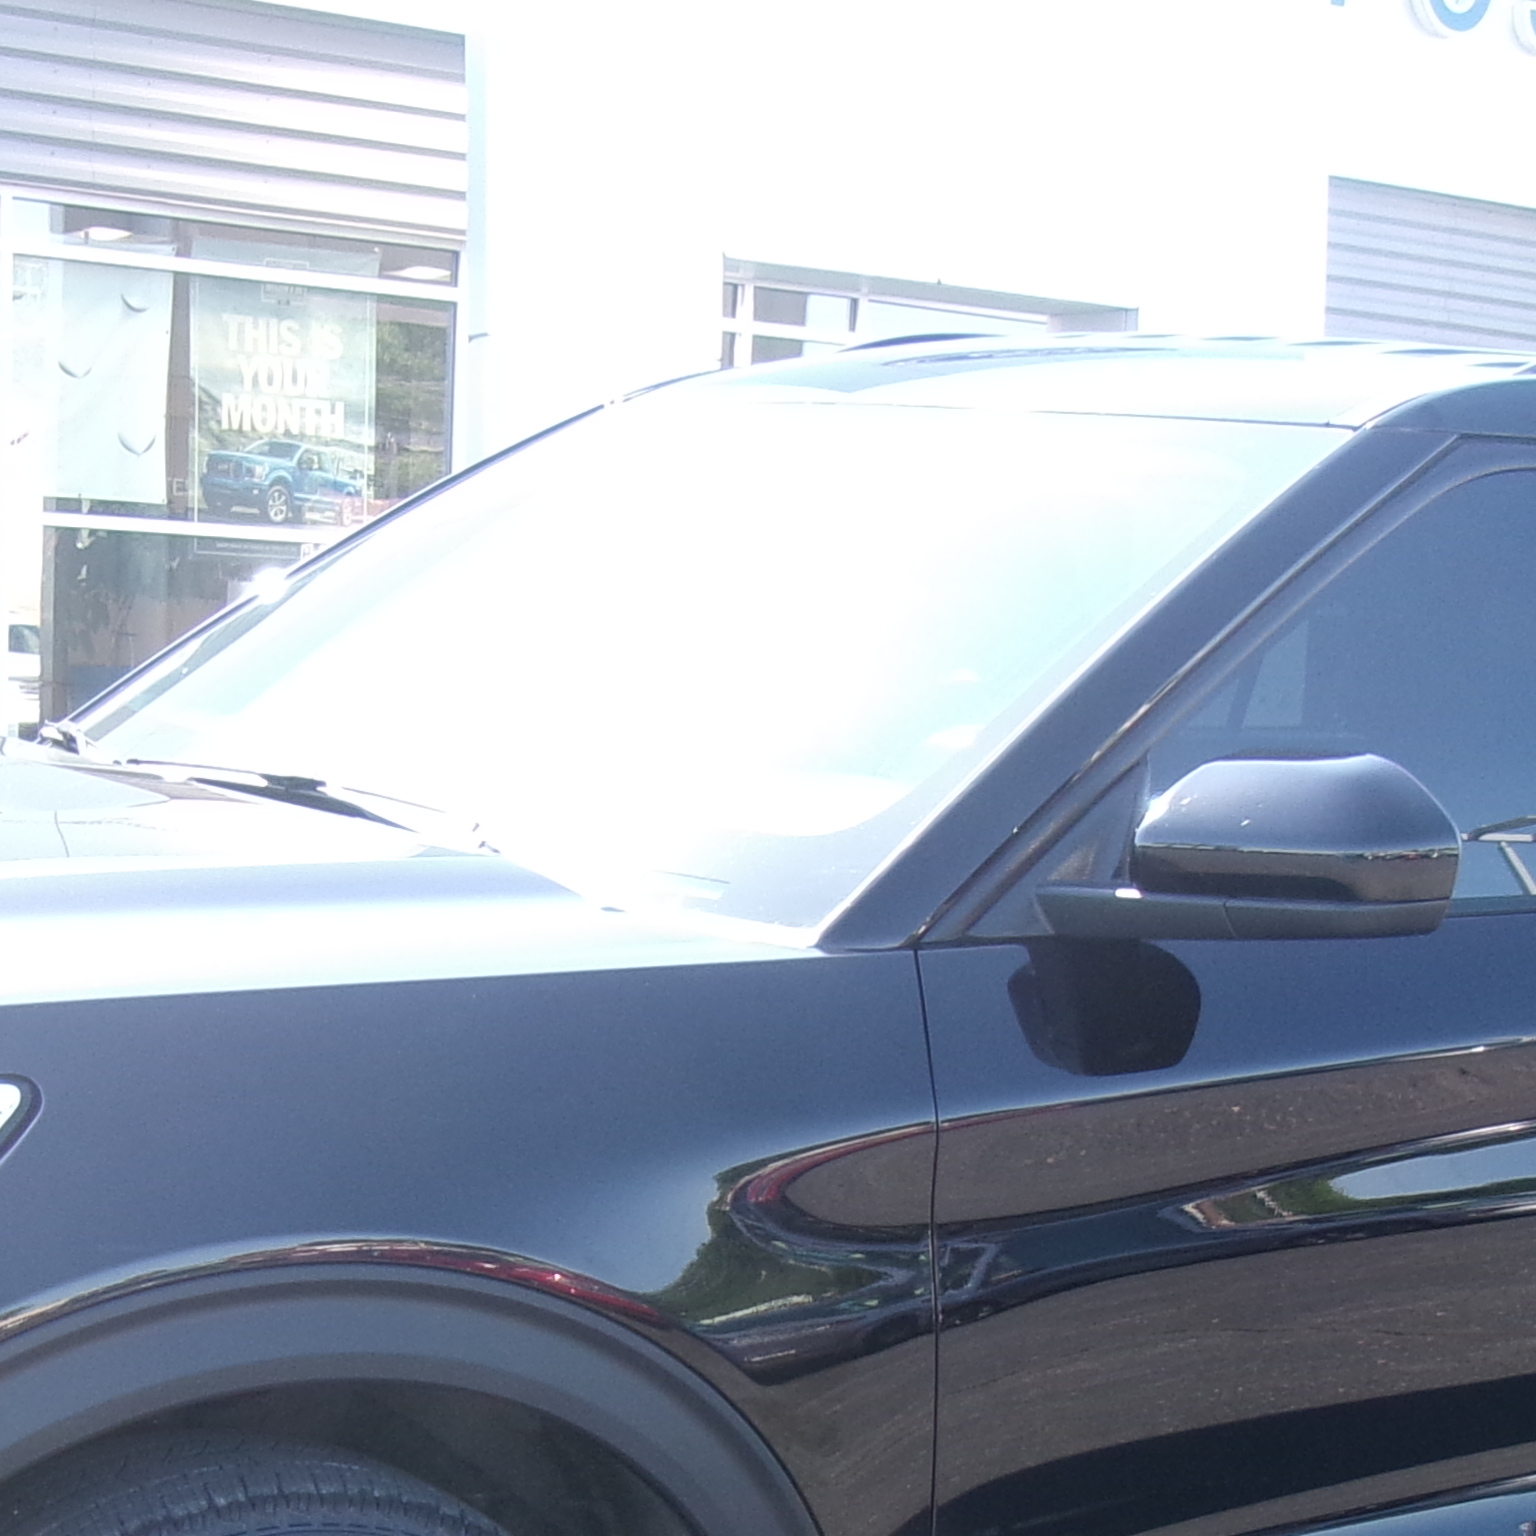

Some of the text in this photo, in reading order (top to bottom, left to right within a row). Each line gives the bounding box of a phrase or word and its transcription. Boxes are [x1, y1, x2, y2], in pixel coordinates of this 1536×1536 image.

[221, 313, 344, 360] THIS IS
[237, 354, 331, 398] YOUR
[221, 392, 345, 438] MONTH
